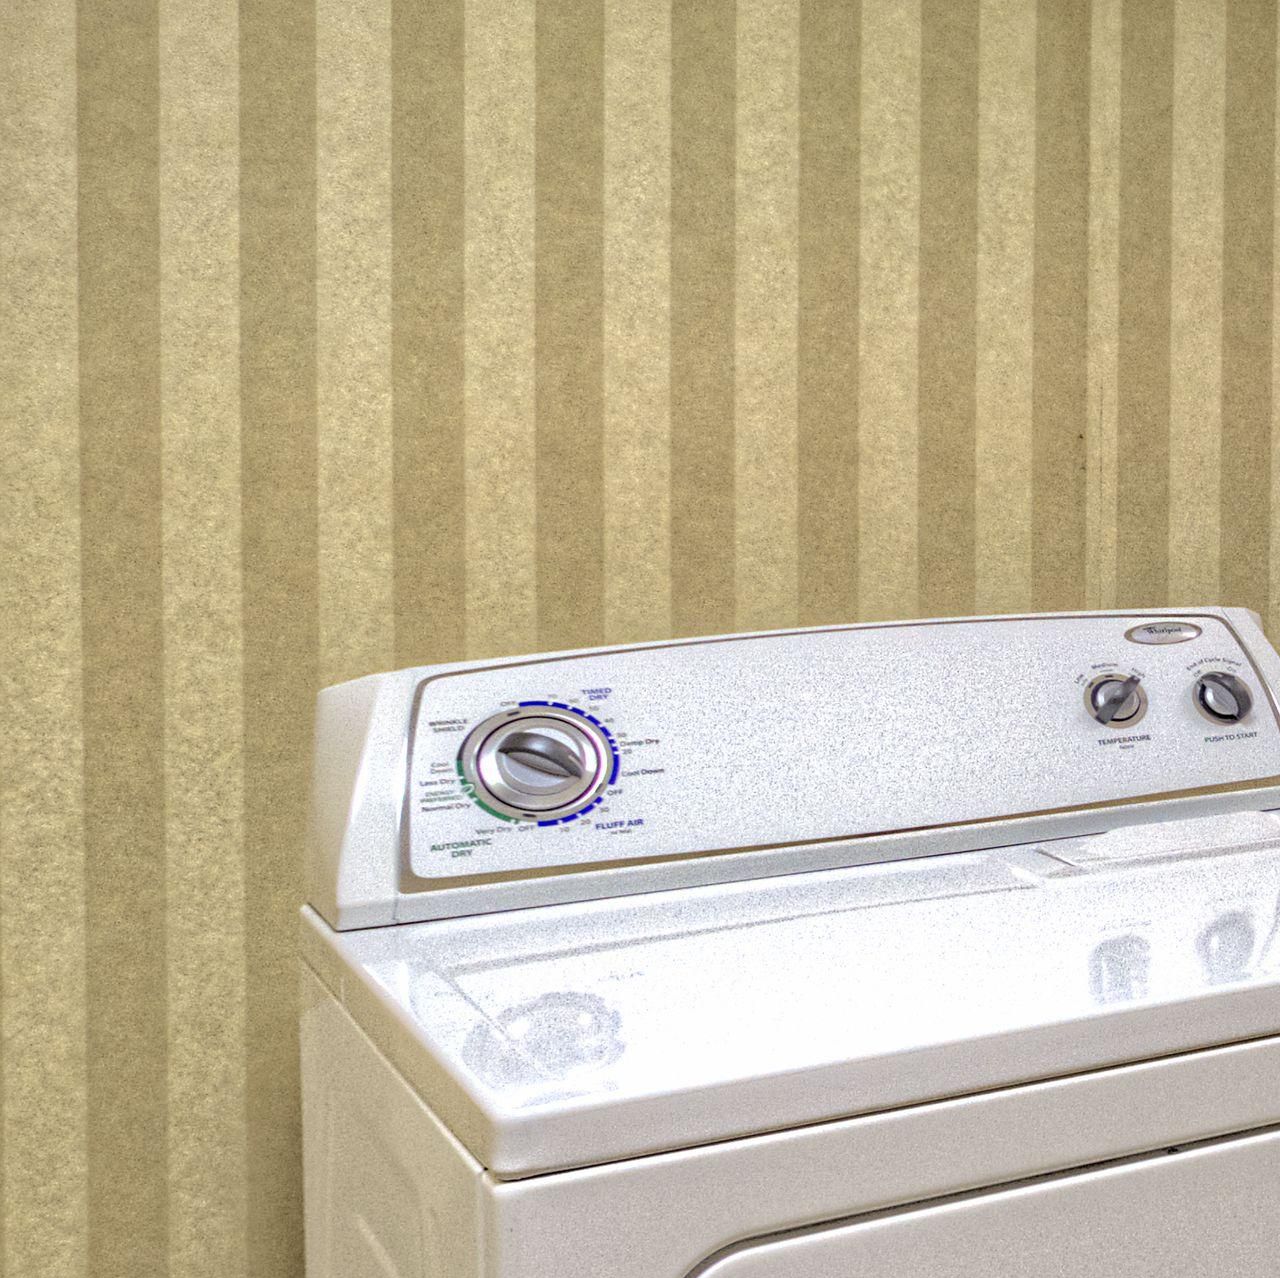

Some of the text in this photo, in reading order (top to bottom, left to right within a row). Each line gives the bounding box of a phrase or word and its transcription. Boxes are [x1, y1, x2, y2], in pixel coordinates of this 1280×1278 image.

[1098, 734, 1152, 746] TEMPERATURE
[1204, 731, 1258, 744] PUSH TO START
[606, 788, 623, 796] OFF
[595, 818, 644, 830] FLUFF AIR
[430, 838, 492, 852] AUTOMATIC
[451, 849, 473, 858] DRY
